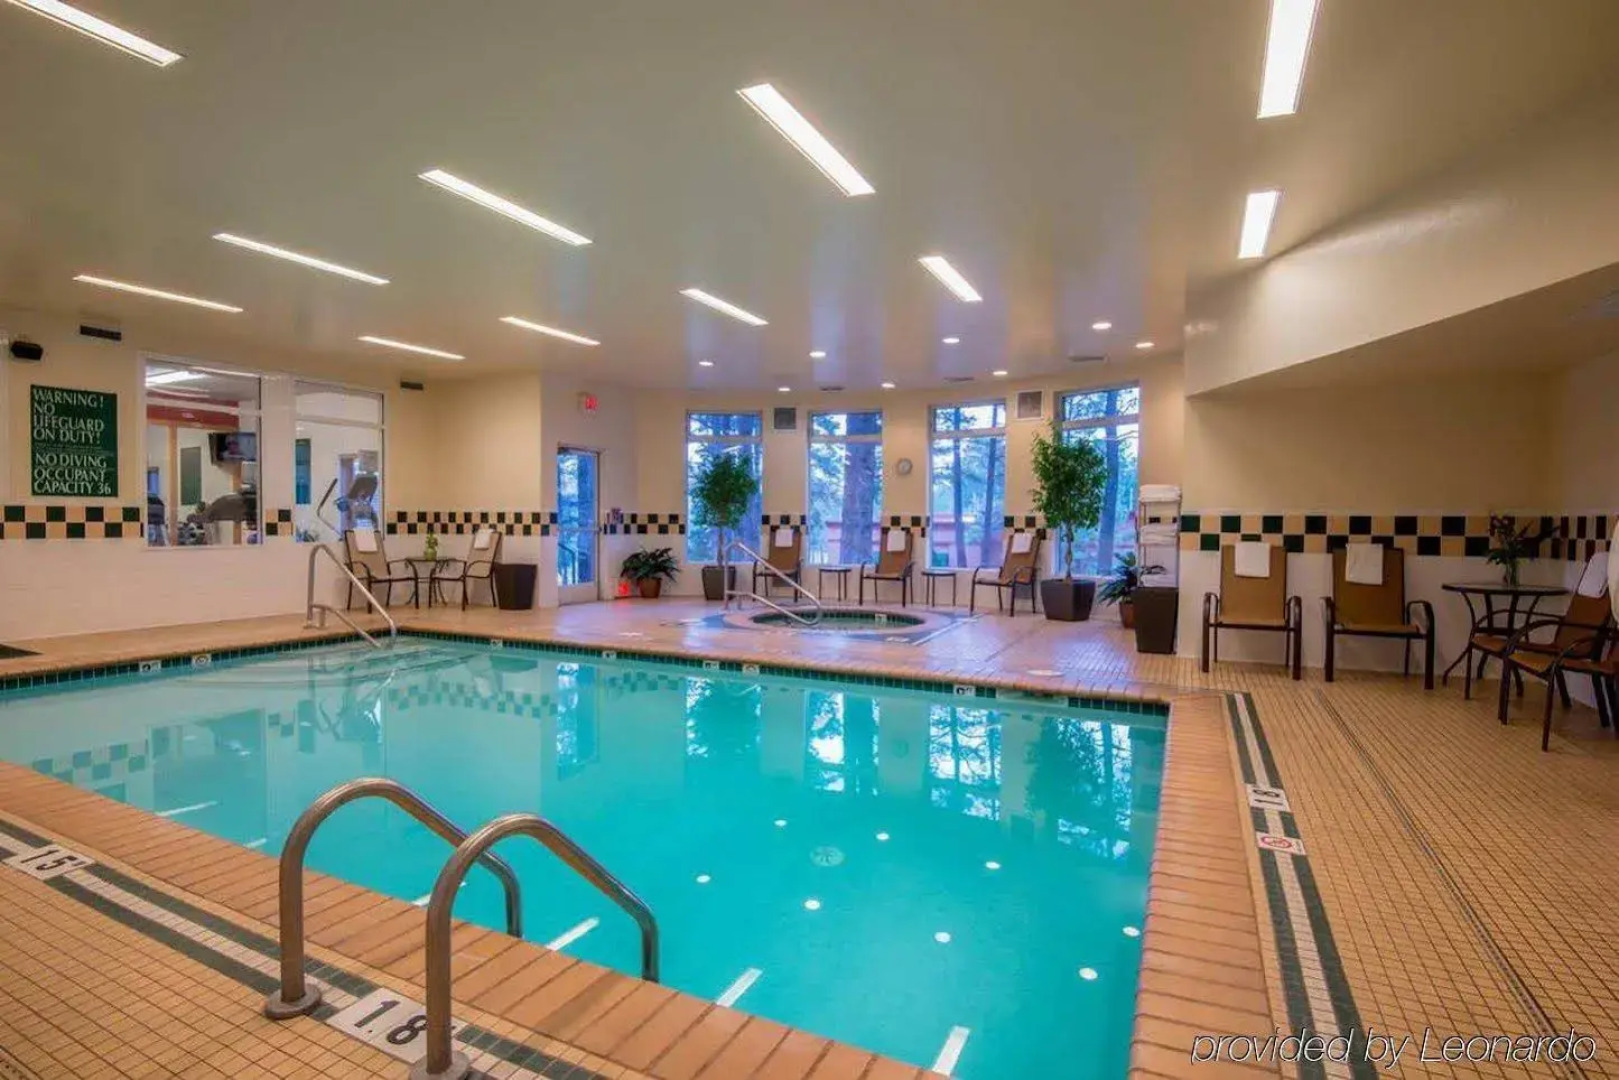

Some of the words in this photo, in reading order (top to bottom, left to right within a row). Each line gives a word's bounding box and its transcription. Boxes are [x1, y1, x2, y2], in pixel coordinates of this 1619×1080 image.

[34, 402, 56, 416] NO
[33, 415, 105, 432] LIFEGUARD
[33, 427, 56, 441] ON
[60, 430, 101, 444] DUTY!
[35, 452, 57, 466] NO
[60, 454, 107, 468] DIVING
[34, 466, 105, 482] OCCUPANT
[33, 480, 94, 494] CAPACITY
[97, 482, 112, 495] 36
